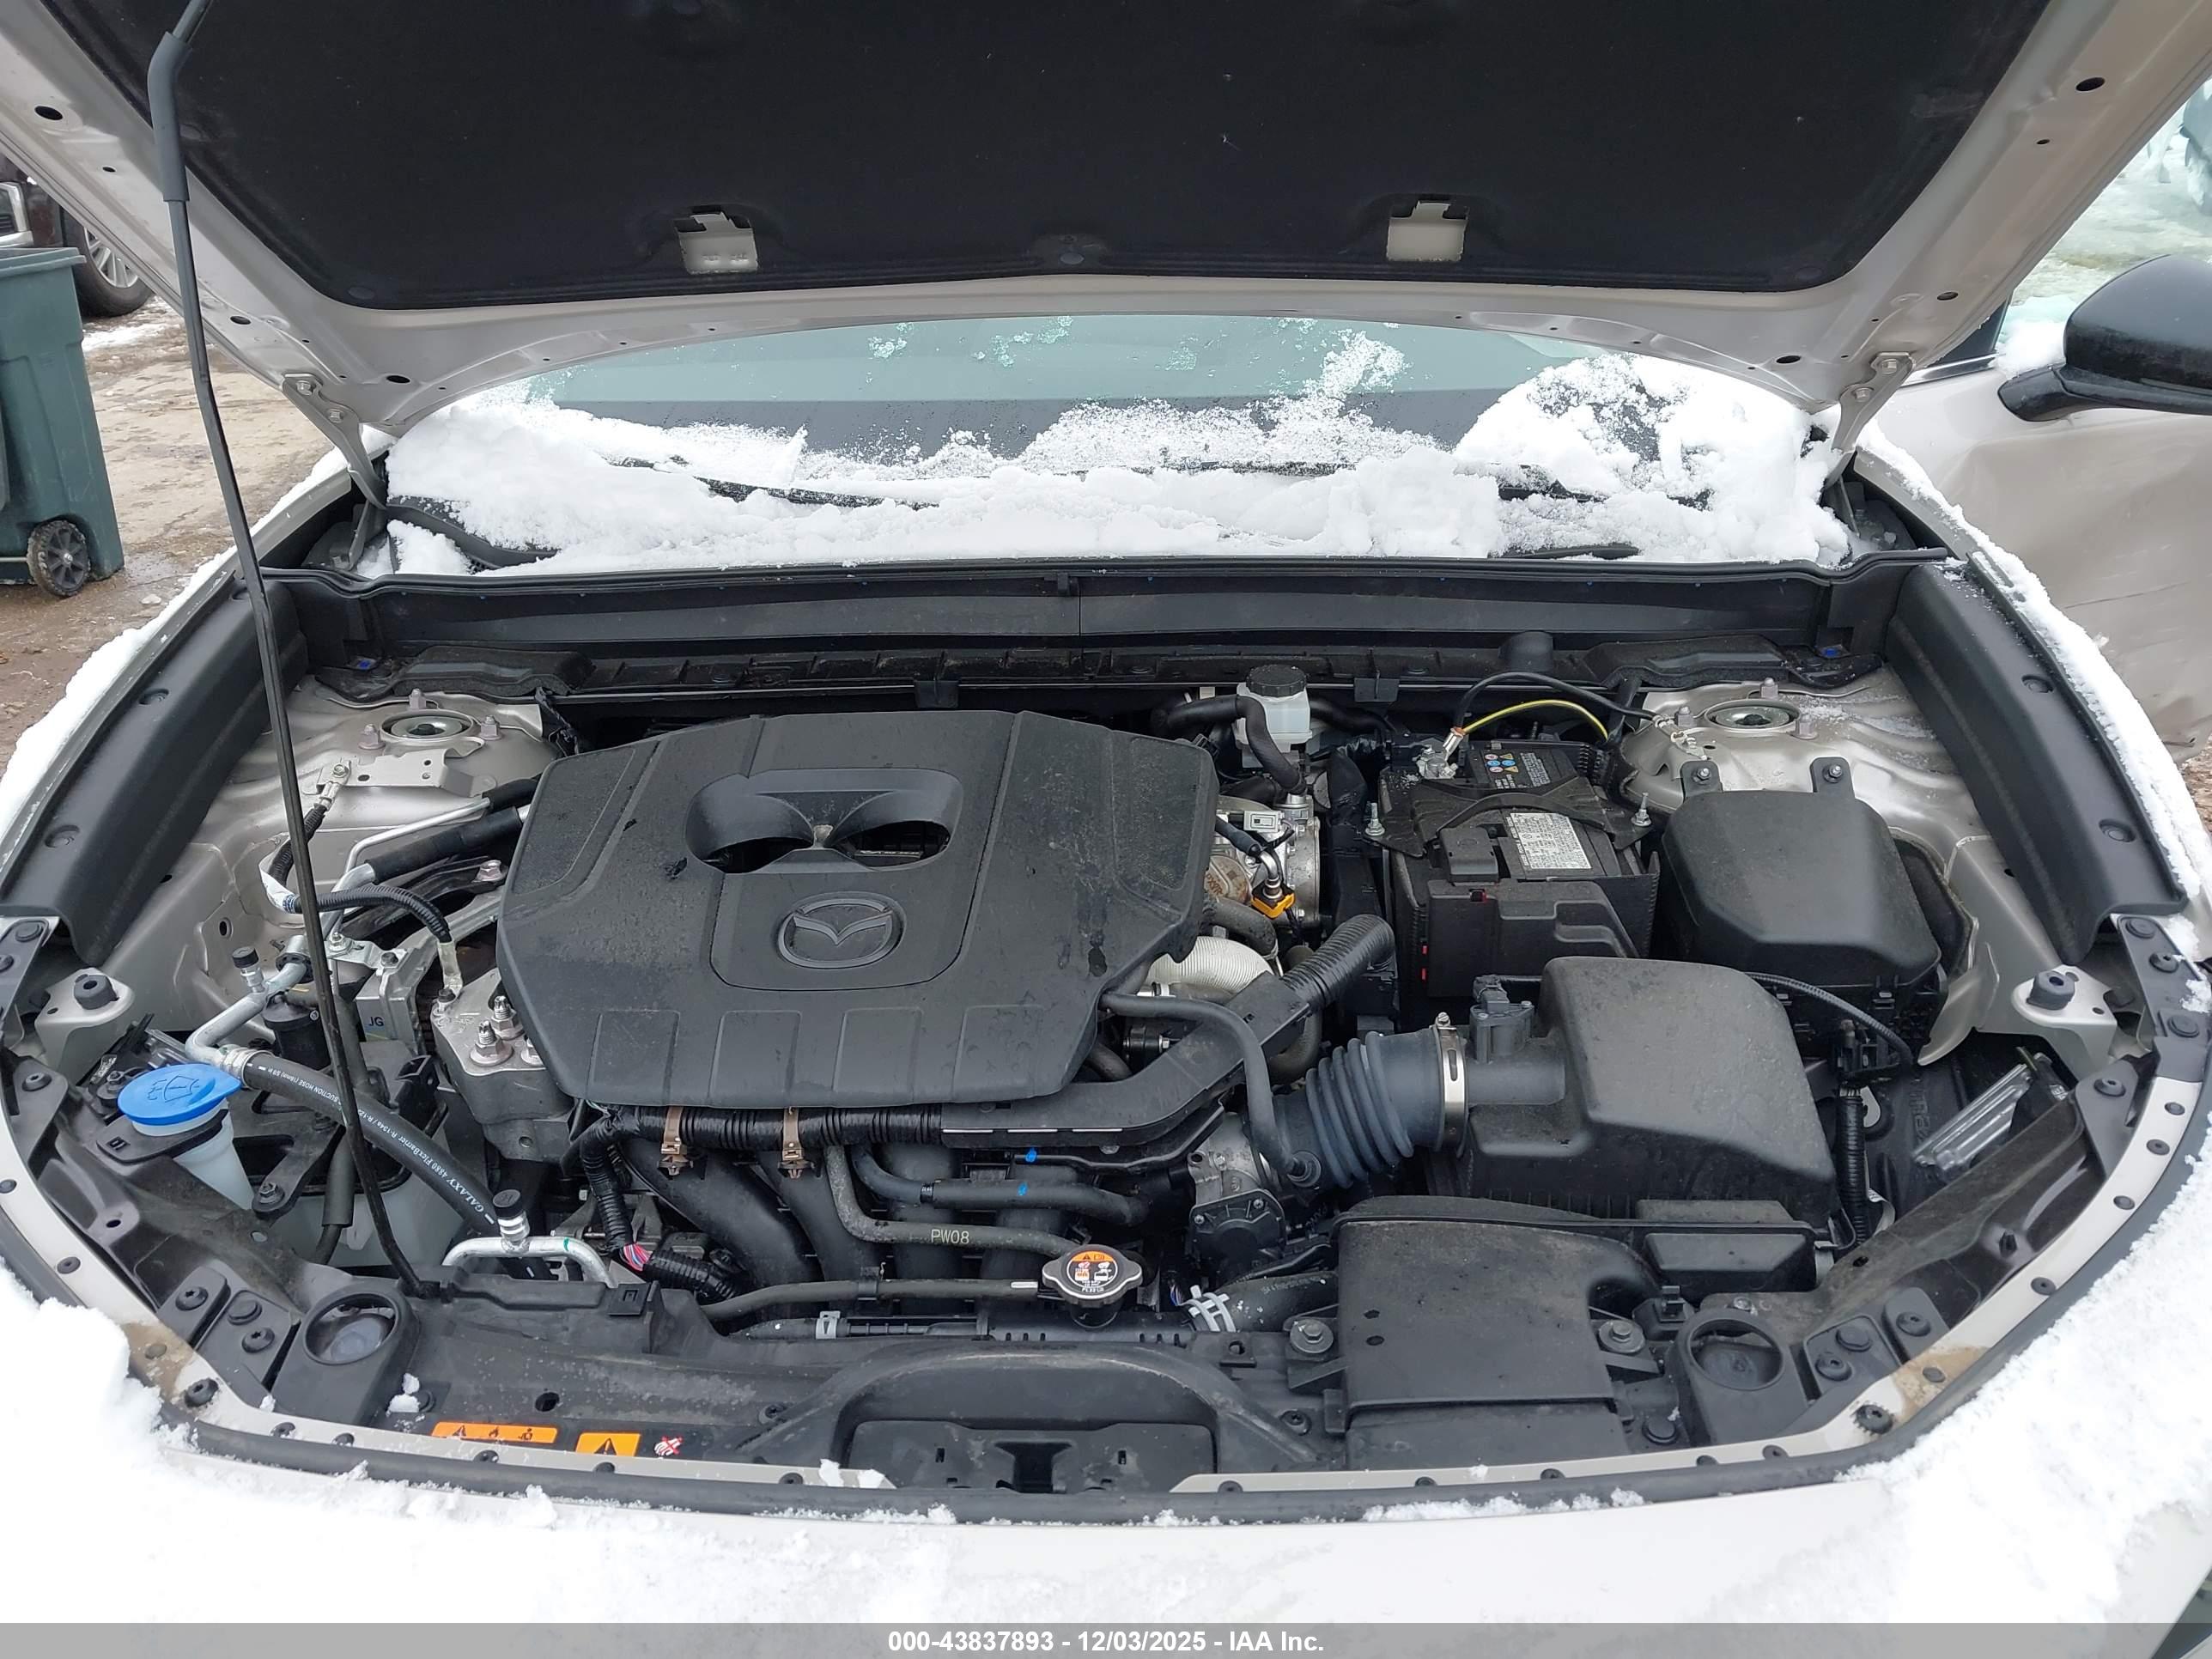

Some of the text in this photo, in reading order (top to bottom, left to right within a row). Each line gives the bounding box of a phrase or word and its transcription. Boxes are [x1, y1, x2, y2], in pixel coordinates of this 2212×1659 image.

[368, 1017, 384, 1026] JG
[298, 1079, 313, 1091] HOSE
[313, 1087, 340, 1103] SUCTION
[398, 1136, 434, 1166] FlexBarrier
[431, 1163, 448, 1179] 4880
[447, 1177, 484, 1212] GALAXY
[931, 1229, 969, 1244] PW08
